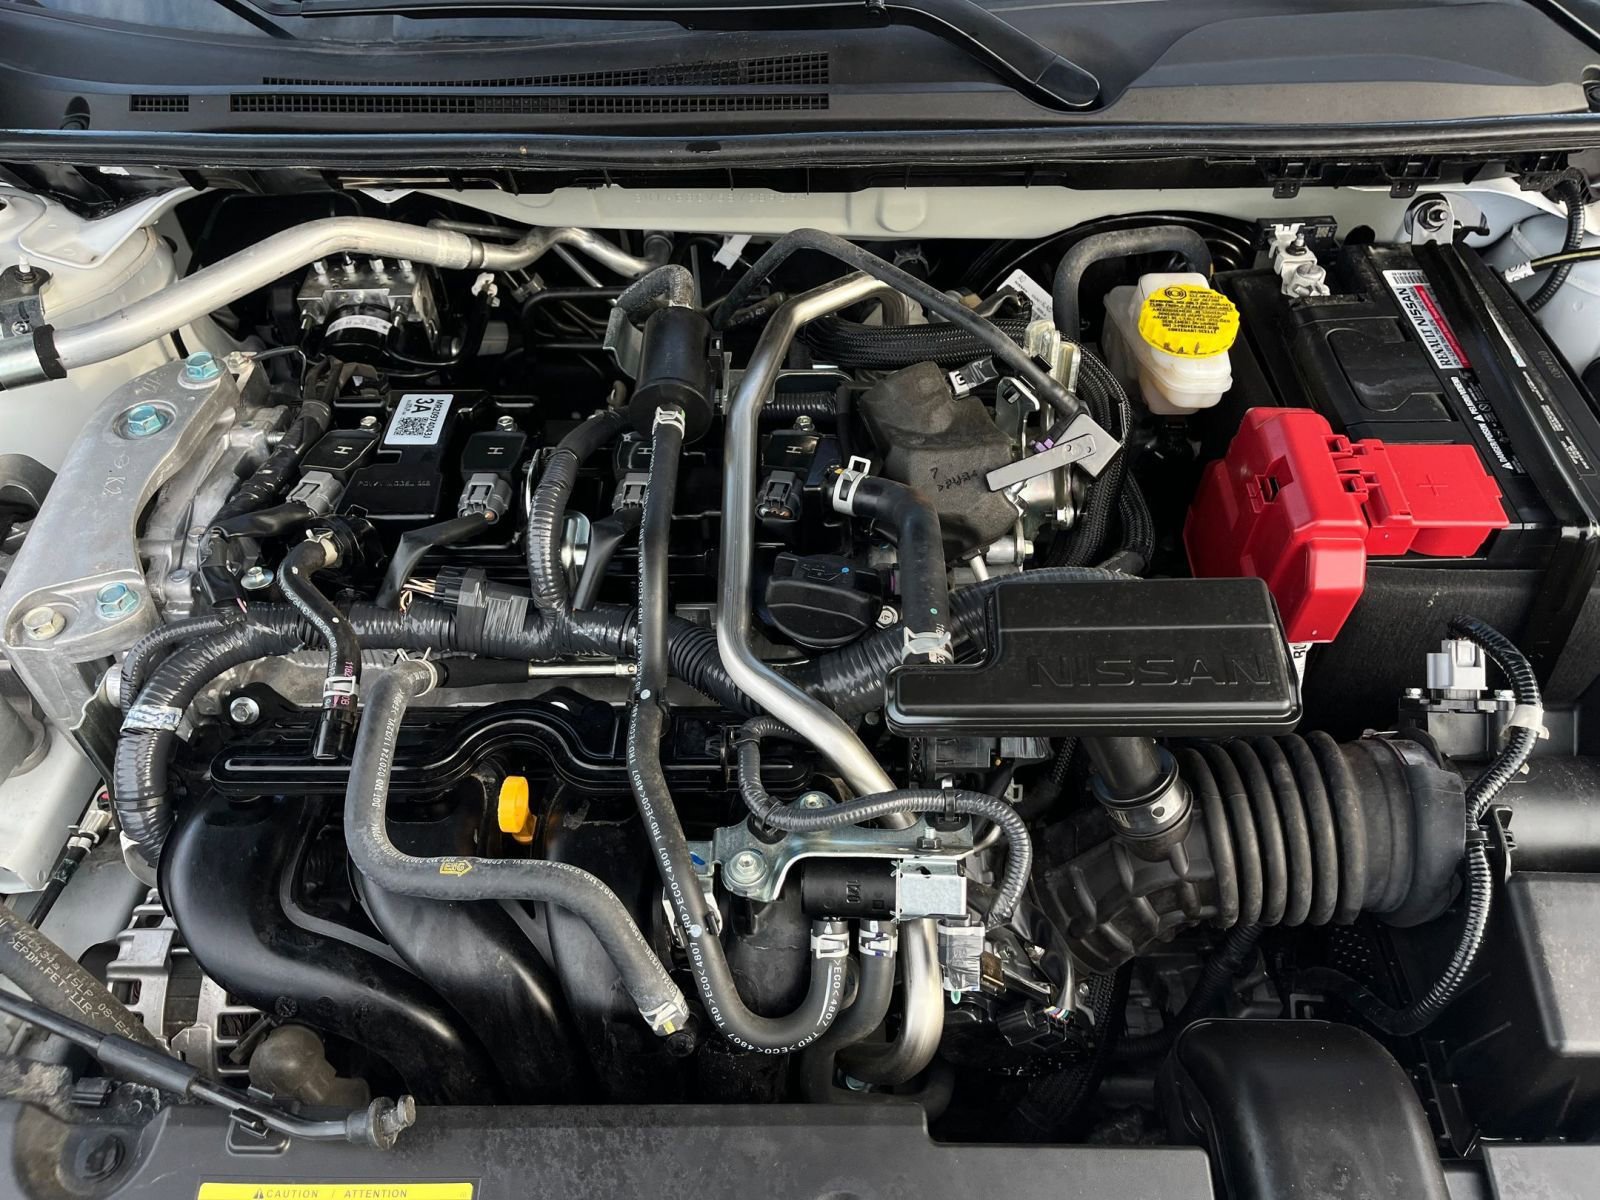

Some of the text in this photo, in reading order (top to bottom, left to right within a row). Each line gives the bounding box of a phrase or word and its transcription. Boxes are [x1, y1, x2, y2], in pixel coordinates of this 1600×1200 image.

[1396, 288, 1428, 326] NISSAN
[1422, 324, 1451, 367] RENAULT
[411, 398, 434, 413] 3A
[1028, 655, 1272, 687] NISSAN
[377, 747, 390, 776] 020724
[266, 1190, 319, 1199] CAUTION
[344, 1190, 408, 1199] ATTENTION
